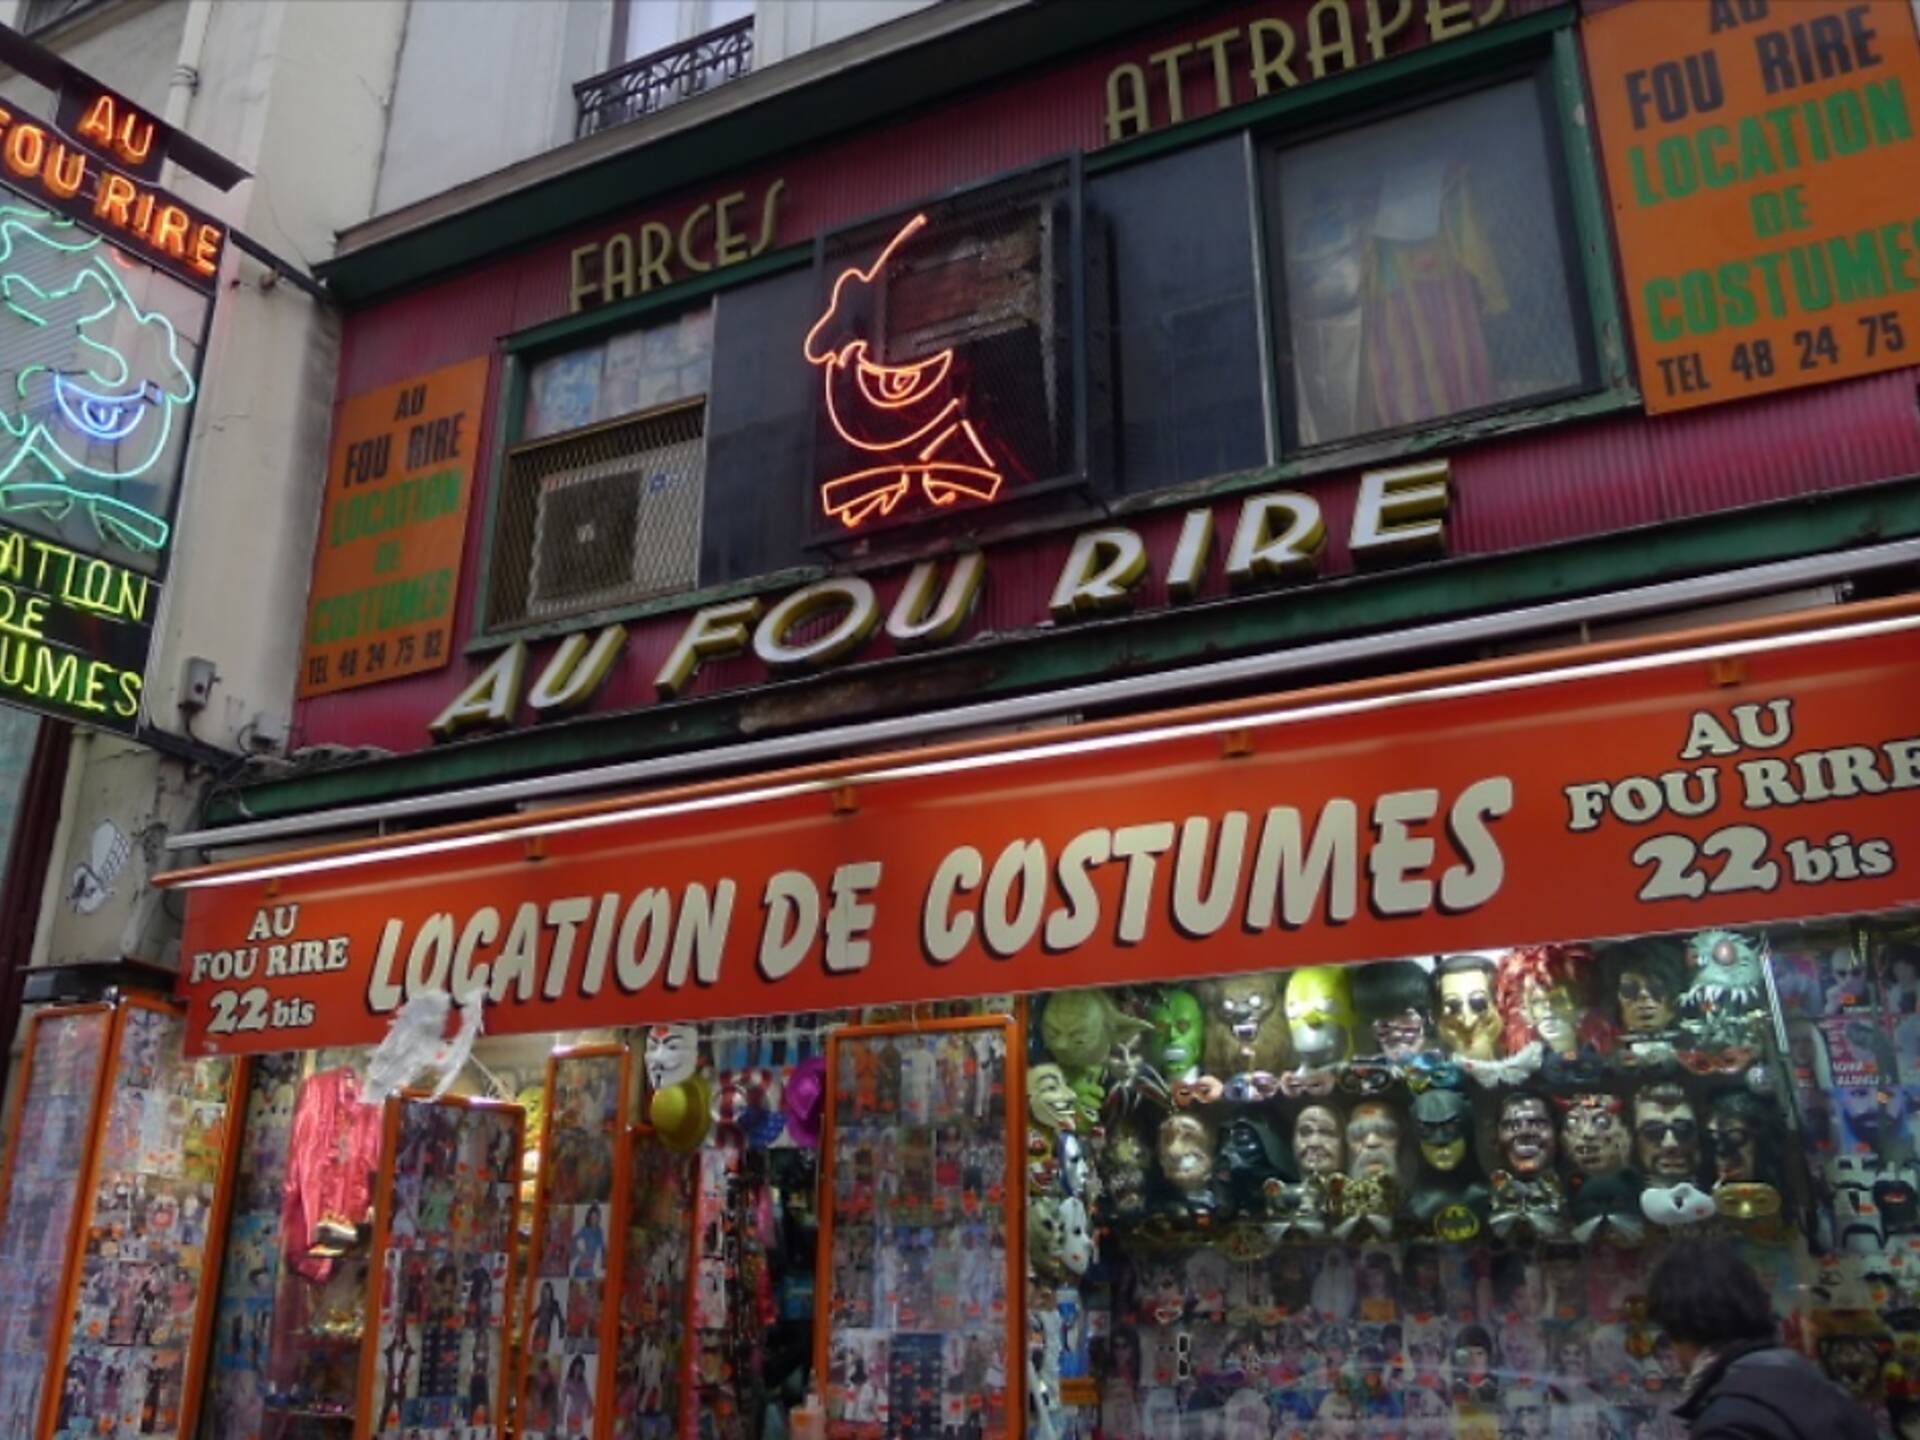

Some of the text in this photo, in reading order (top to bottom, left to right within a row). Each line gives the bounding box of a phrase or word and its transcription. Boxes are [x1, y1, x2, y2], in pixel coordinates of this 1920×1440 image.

[1710, 0, 1769, 34] AU
[1625, 5, 1882, 130] FOU RIRE
[79, 95, 154, 165] AU
[1626, 76, 1914, 208] LOCATION
[95, 172, 222, 275] RIRE
[569, 178, 784, 313] FARCES
[1749, 183, 1813, 239] DE
[1642, 215, 1920, 343] COSTUME
[1657, 311, 1905, 397] TEL 48 24 75
[395, 384, 427, 421] AU
[344, 412, 465, 488] FOU RIRE
[331, 468, 462, 547] LOCATION
[311, 567, 454, 645] COSTUMES
[429, 459, 1451, 742] AU FOU RIRE
[1679, 698, 1793, 760] AU
[1564, 740, 1920, 832] FOU RIRE
[367, 775, 1514, 1014] LOCATION DE COSTUMES
[1632, 824, 1895, 902] 22 bis
[189, 936, 350, 983] FOU RIRE
[247, 905, 299, 941] AU
[207, 987, 315, 1034] 22 bis
